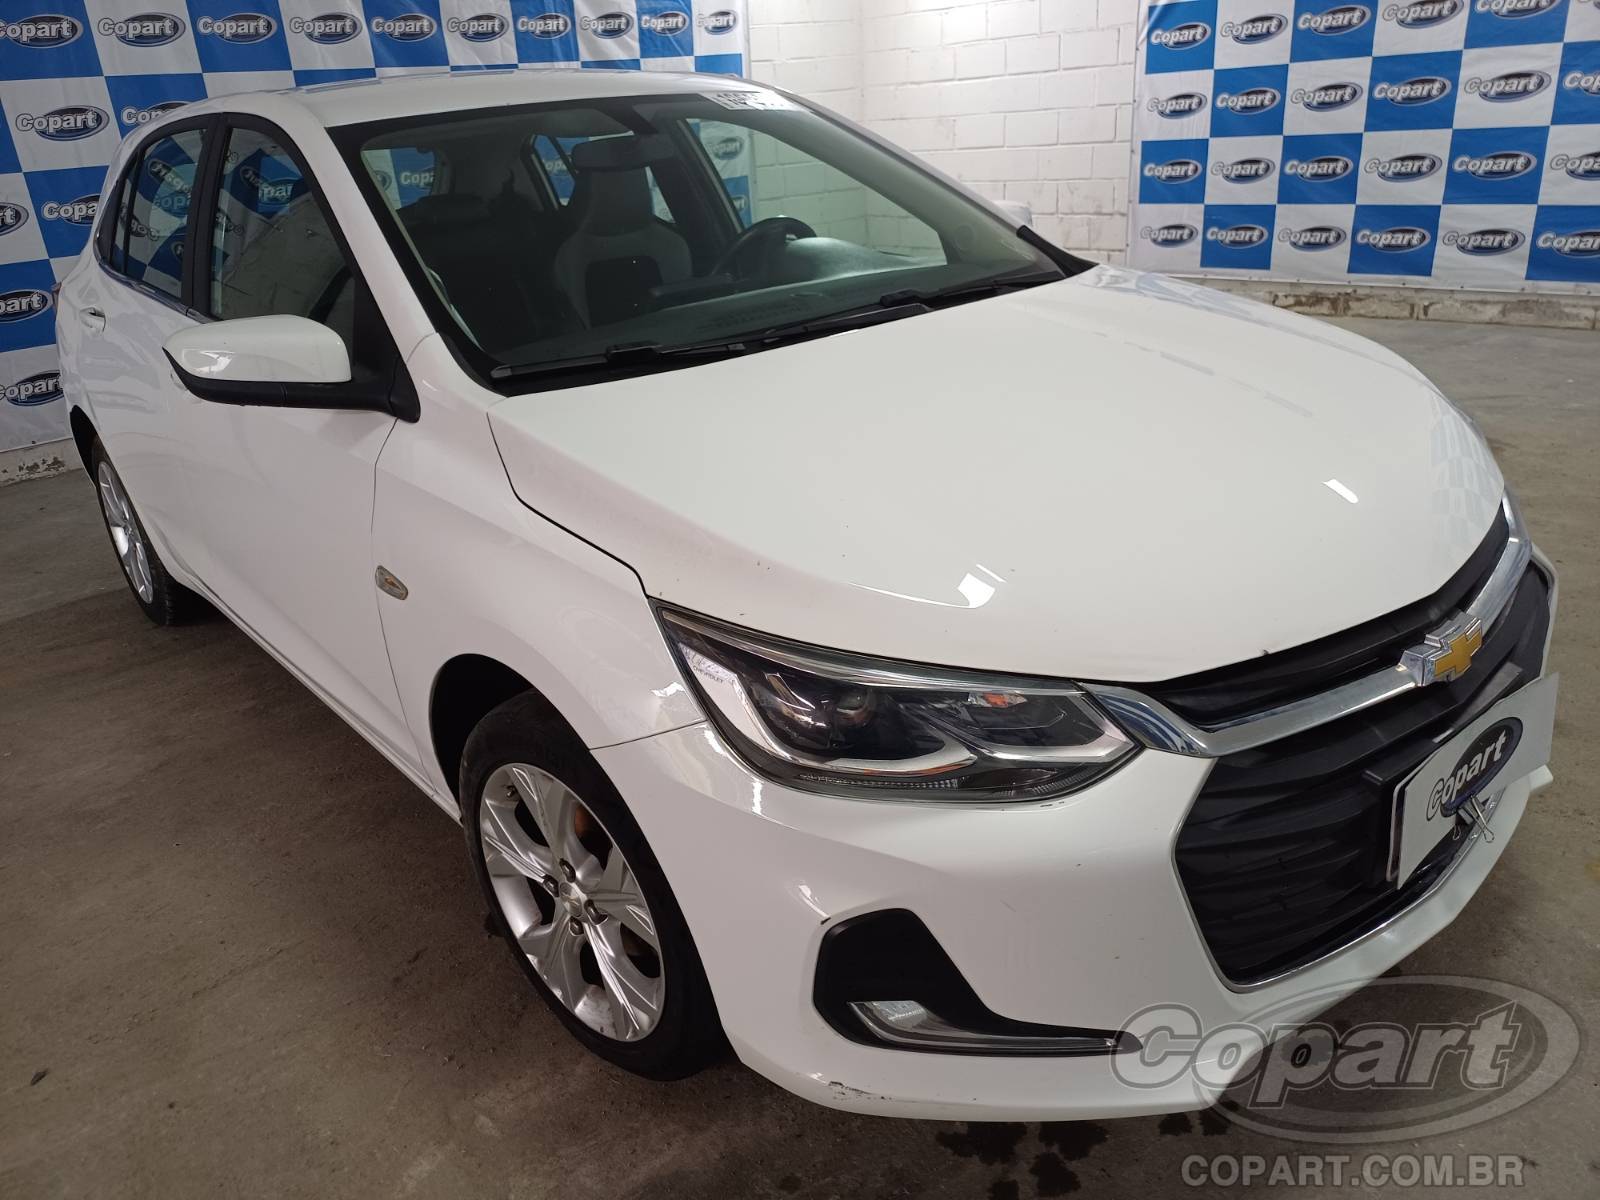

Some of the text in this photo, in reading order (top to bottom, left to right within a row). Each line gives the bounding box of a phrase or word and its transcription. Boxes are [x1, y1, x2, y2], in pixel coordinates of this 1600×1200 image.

[1299, 9, 1361, 30] Copart
[1383, 1, 1451, 22] Copart
[99, 17, 174, 39] Copart
[199, 16, 269, 37] Copart
[291, 16, 354, 36] Copart
[372, 16, 431, 36] Copart
[448, 16, 501, 36] Copart
[518, 16, 566, 35] Copart
[581, 15, 628, 34] Copart
[642, 14, 686, 32] Copart
[699, 13, 735, 31] Copart
[1221, 18, 1279, 40] Copart
[1151, 26, 1204, 46] Copart
[1374, 80, 1442, 102] Copart
[1464, 75, 1539, 96] Copart
[1564, 72, 1600, 91] Cop
[1147, 95, 1200, 114] Copart
[1216, 90, 1273, 110] Copart
[1291, 85, 1353, 107] Copart
[16, 111, 98, 131] Copart
[1144, 162, 1196, 180] Copart
[1211, 160, 1268, 179] Copart
[1285, 158, 1346, 177] Copart
[1364, 156, 1431, 176] Copart
[1453, 153, 1528, 175] Copart
[1551, 155, 1600, 174] Copa
[43, 202, 97, 222] Copa
[1141, 226, 1192, 243] Copart
[1207, 227, 1262, 245] Copart
[1278, 227, 1339, 246] Copart
[1357, 228, 1422, 248] Copart
[1443, 230, 1513, 250] Copart
[1536, 232, 1600, 253] Copar
[1427, 729, 1506, 821] Copart
